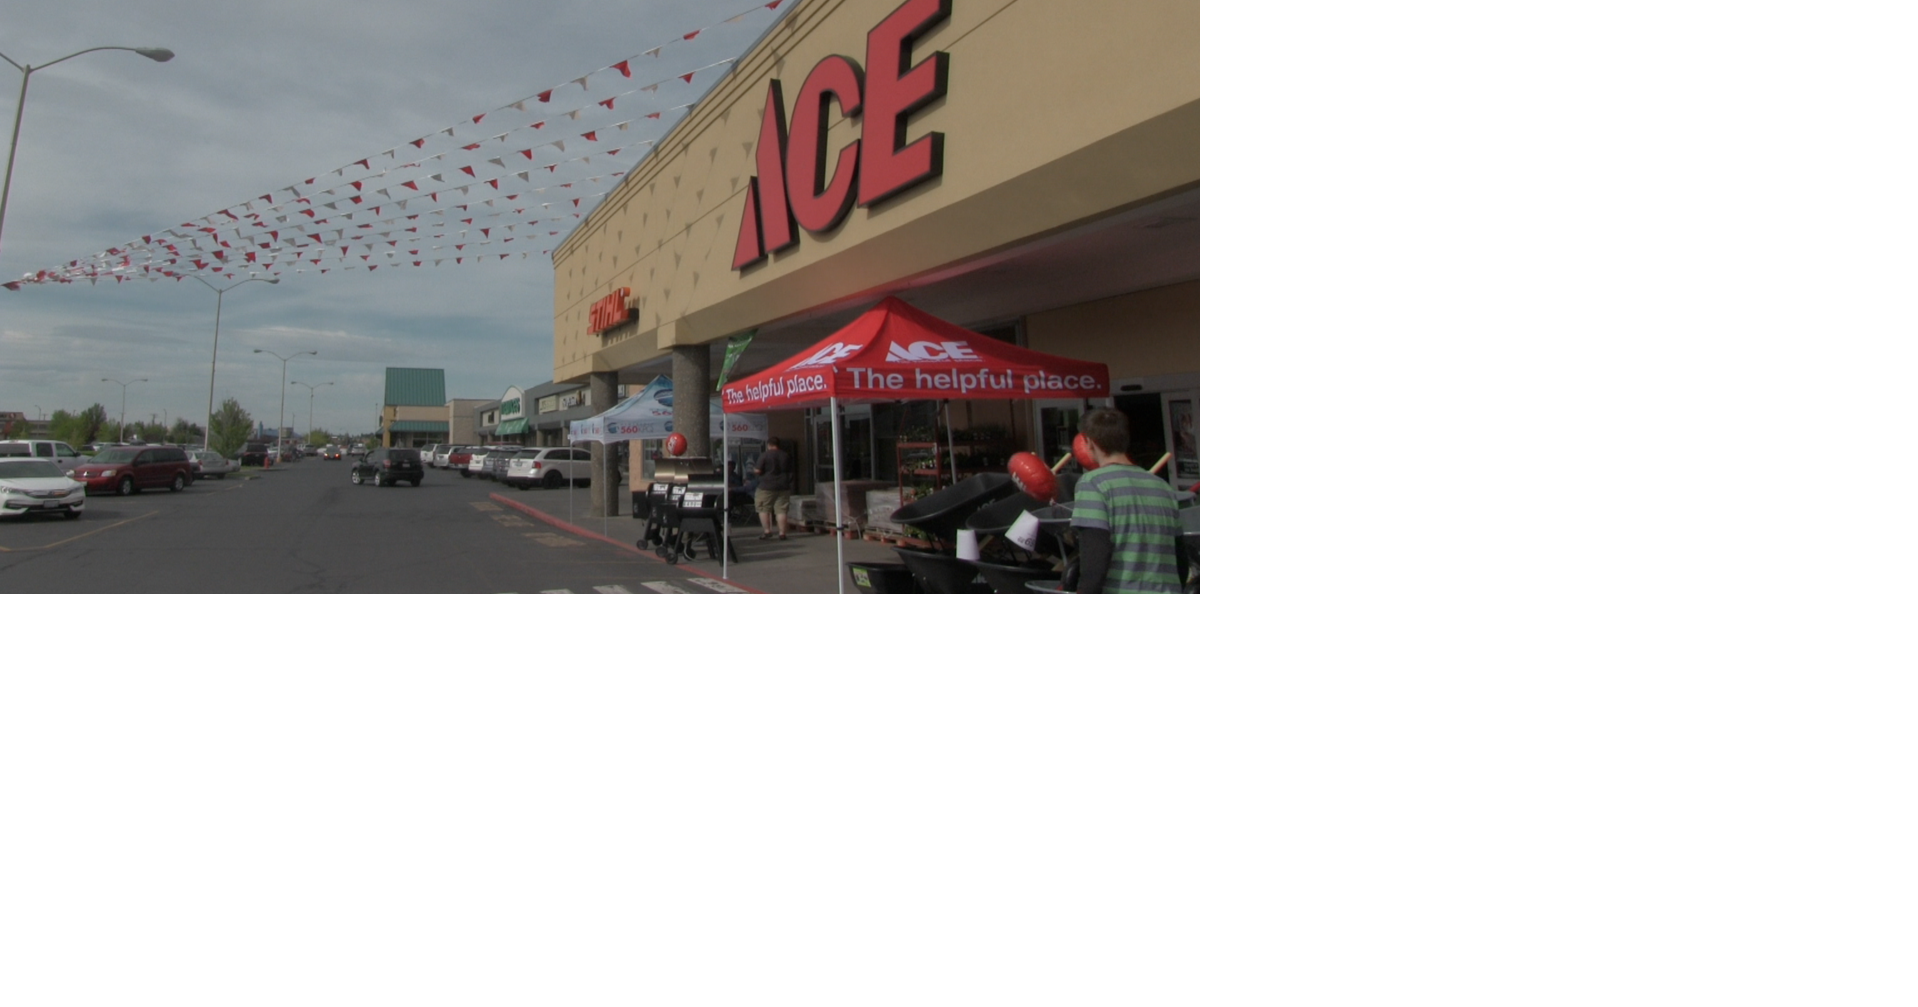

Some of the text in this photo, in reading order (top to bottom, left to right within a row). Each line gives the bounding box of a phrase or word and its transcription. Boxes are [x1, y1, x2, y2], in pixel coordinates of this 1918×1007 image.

[731, 0, 945, 272] ACE
[587, 287, 629, 335] STIHL
[788, 342, 864, 371] ACE
[885, 341, 979, 362] ACE
[725, 374, 827, 405] The helpful place.
[846, 367, 1102, 393] The helpful place.
[620, 425, 638, 434] 560
[732, 424, 748, 432] 560
